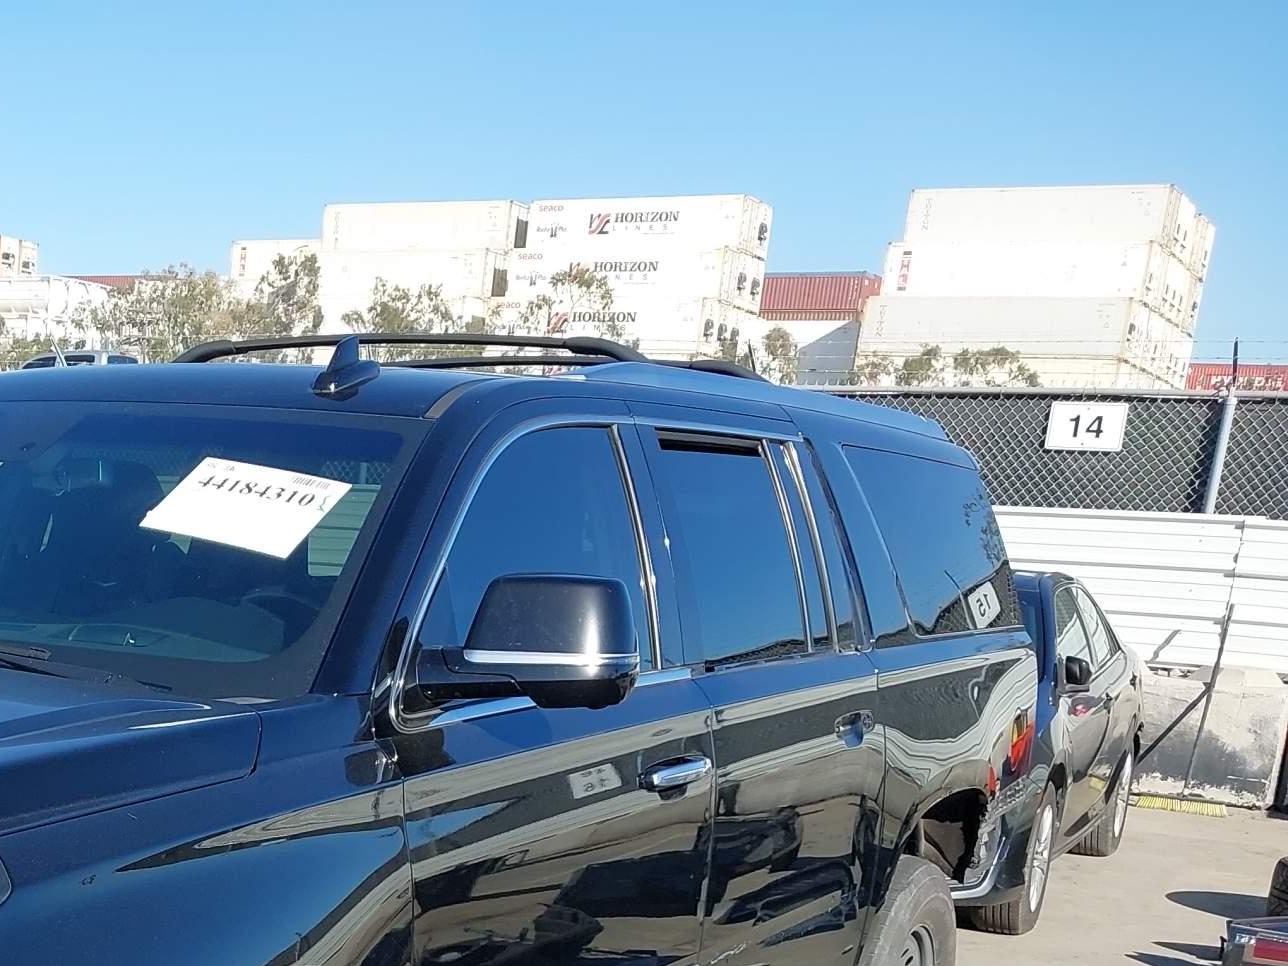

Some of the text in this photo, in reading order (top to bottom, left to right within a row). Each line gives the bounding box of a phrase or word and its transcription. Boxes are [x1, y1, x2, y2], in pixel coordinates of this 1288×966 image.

[614, 211, 680, 223] HORIZON
[612, 223, 668, 231] LINES
[593, 260, 659, 272] HORIZON
[571, 311, 637, 323] HORIZON
[1069, 414, 1104, 438] 14
[198, 475, 315, 507] 44184310
